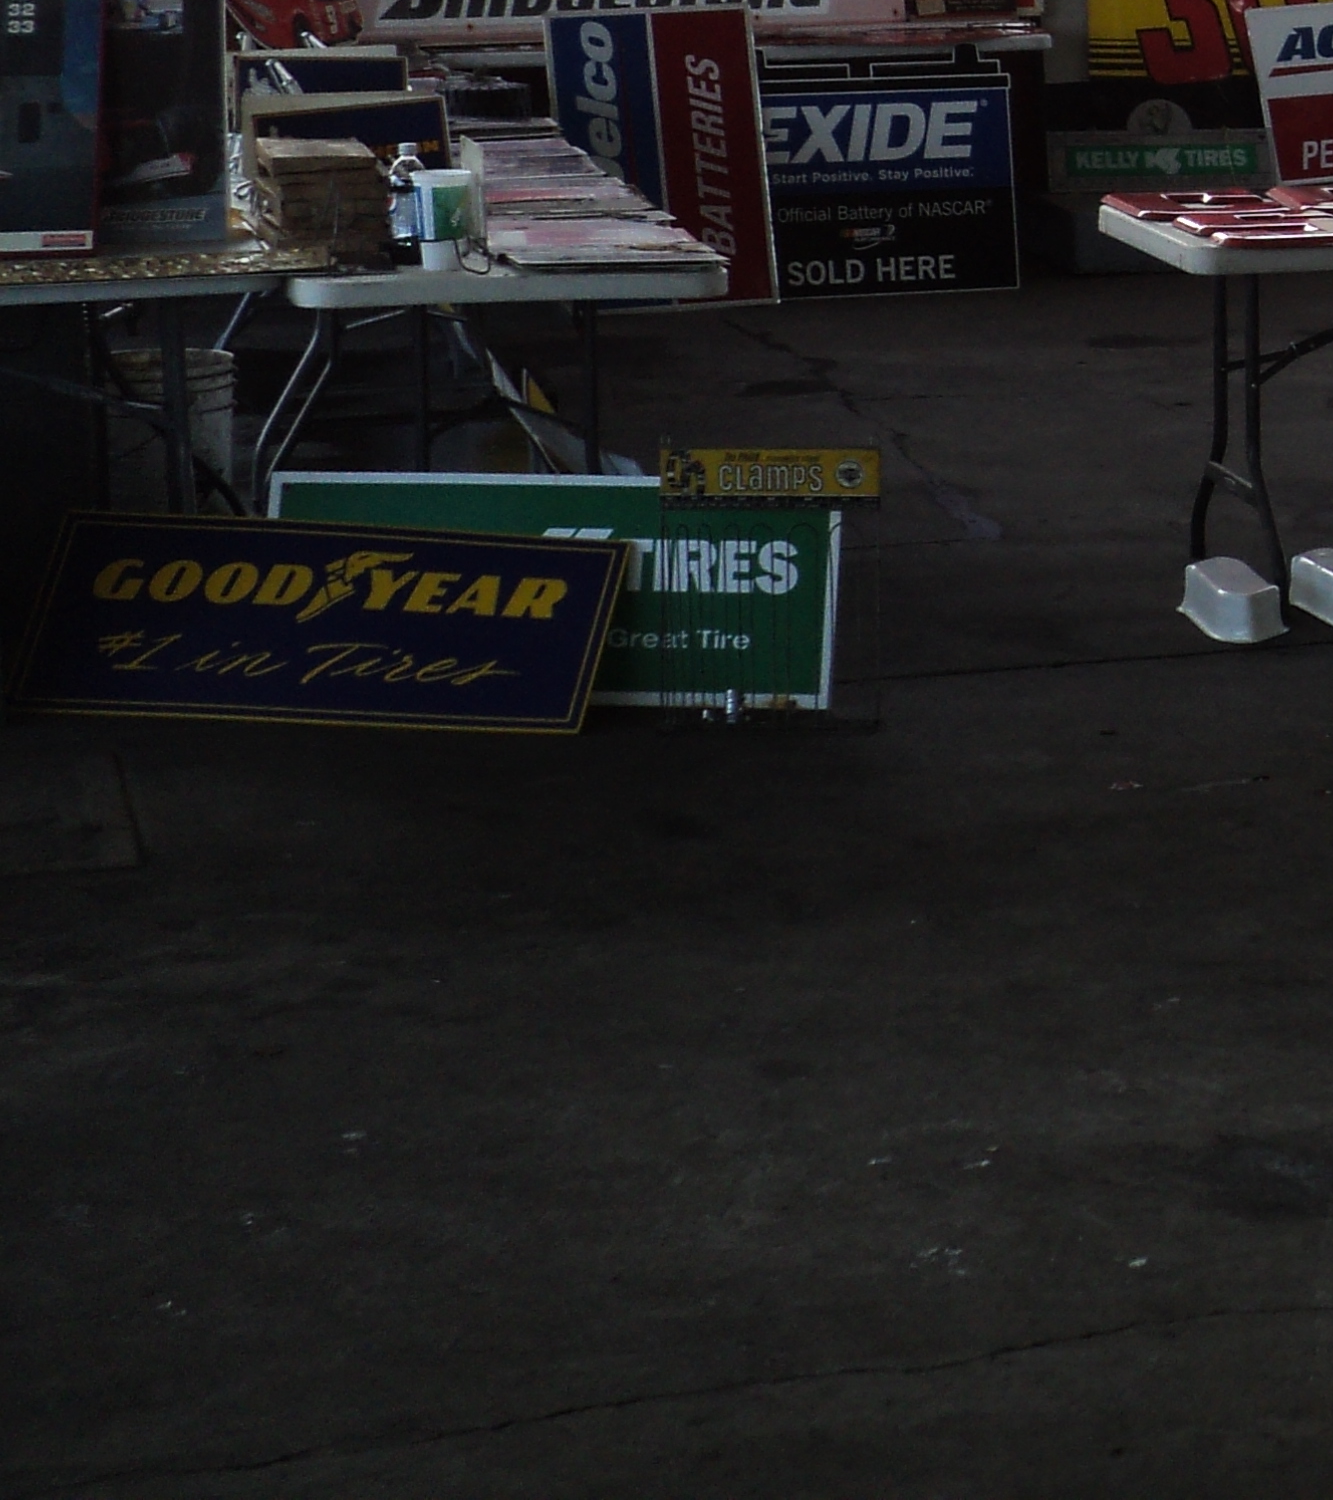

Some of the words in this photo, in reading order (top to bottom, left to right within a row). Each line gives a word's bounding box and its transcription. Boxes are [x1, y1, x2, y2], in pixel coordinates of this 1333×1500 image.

[8, 3, 35, 16] 32
[7, 20, 34, 33] 33
[763, 100, 978, 164] EXIDE
[684, 54, 737, 257] BATTERIES
[1076, 151, 1139, 169] KELLY
[1184, 148, 1248, 167] TIRES
[773, 172, 807, 185] Start
[812, 170, 872, 183] Positive.
[878, 168, 909, 183] Stay
[777, 204, 831, 223] Official
[837, 202, 893, 222] Battery
[899, 203, 913, 218] of
[918, 200, 986, 217] NASCAR
[787, 258, 866, 286] SOLD
[876, 254, 956, 282] HERE
[620, 539, 799, 595] TIRES
[92, 550, 569, 624] GOODYEAR
[608, 628, 688, 649] Great
[697, 629, 751, 650] Tire
[97, 628, 166, 674] #1
[175, 636, 292, 677] in
[300, 642, 522, 688] Tires
